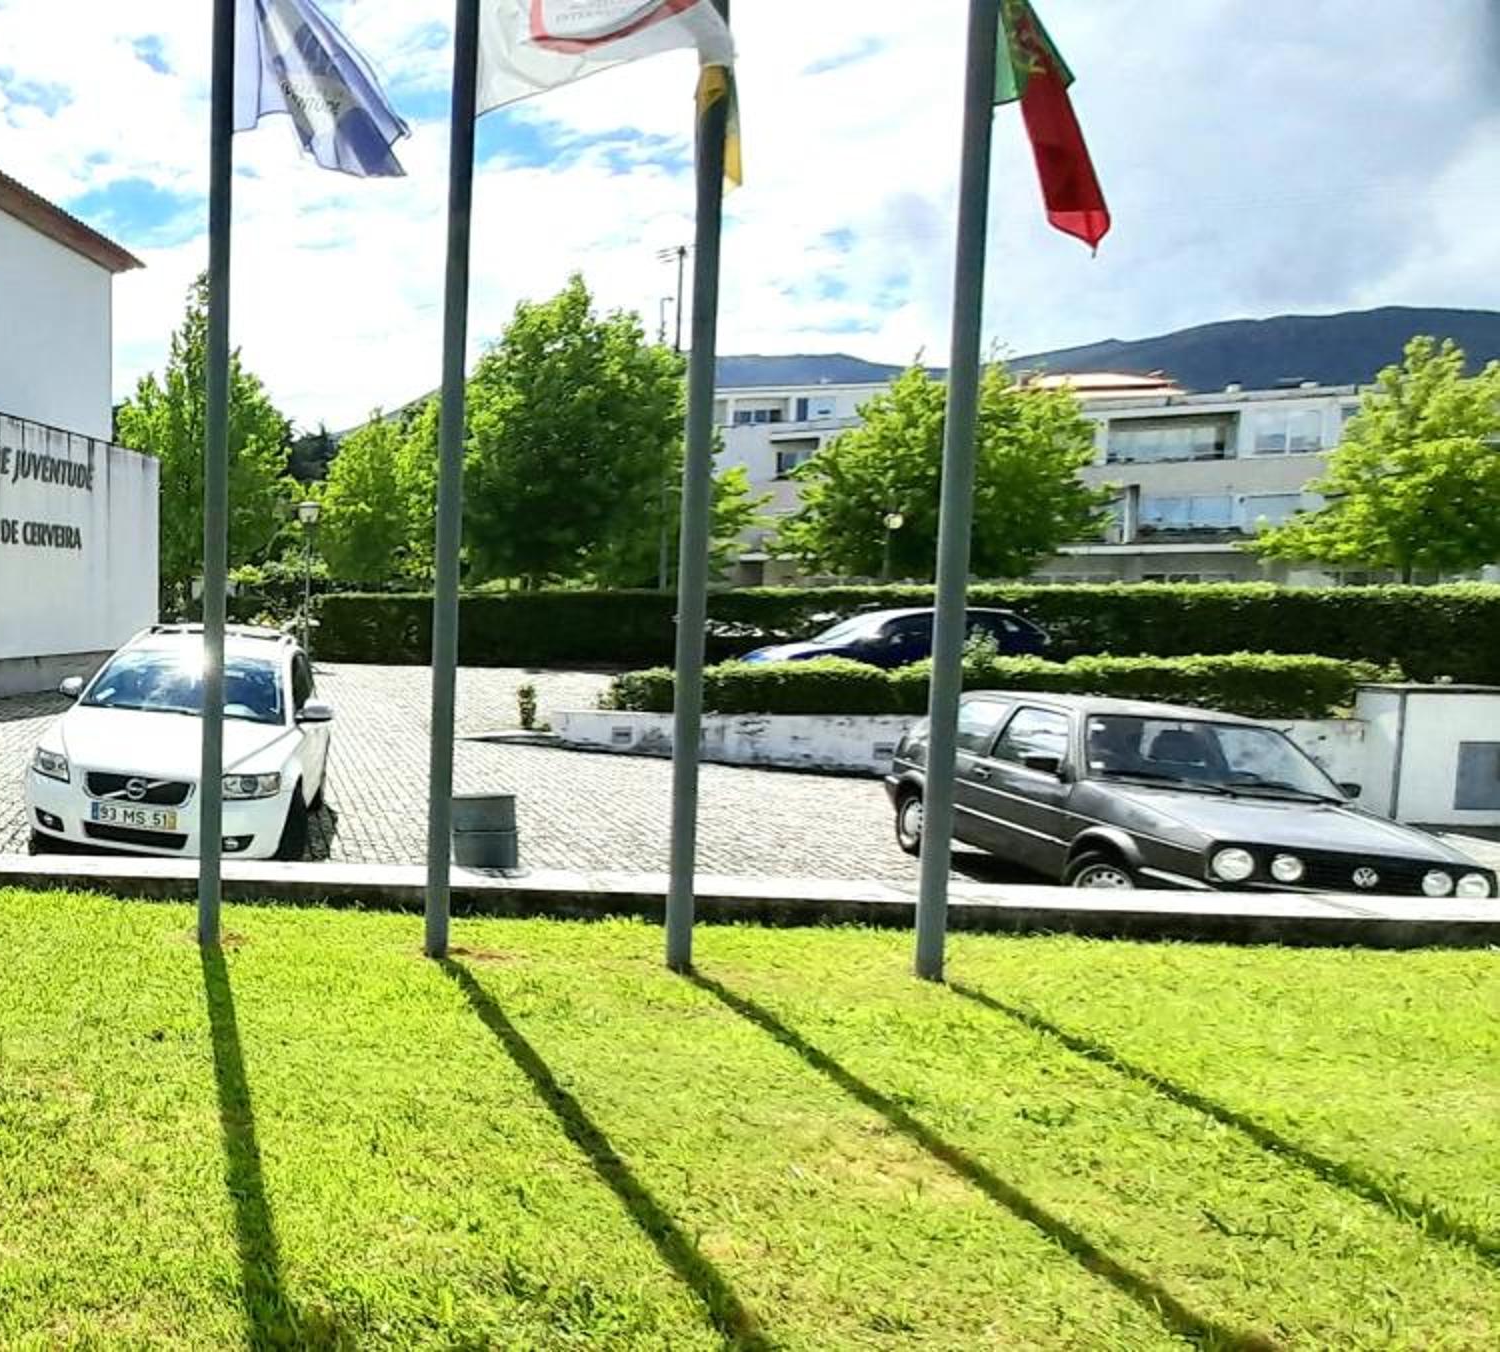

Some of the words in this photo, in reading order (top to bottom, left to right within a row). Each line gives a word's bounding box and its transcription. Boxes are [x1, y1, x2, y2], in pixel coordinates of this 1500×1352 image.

[11, 448, 95, 491] JUVENTUDE
[0, 518, 19, 545] DE
[22, 521, 83, 551] CERVEIRA
[100, 805, 117, 821] 93
[123, 809, 146, 825] MS
